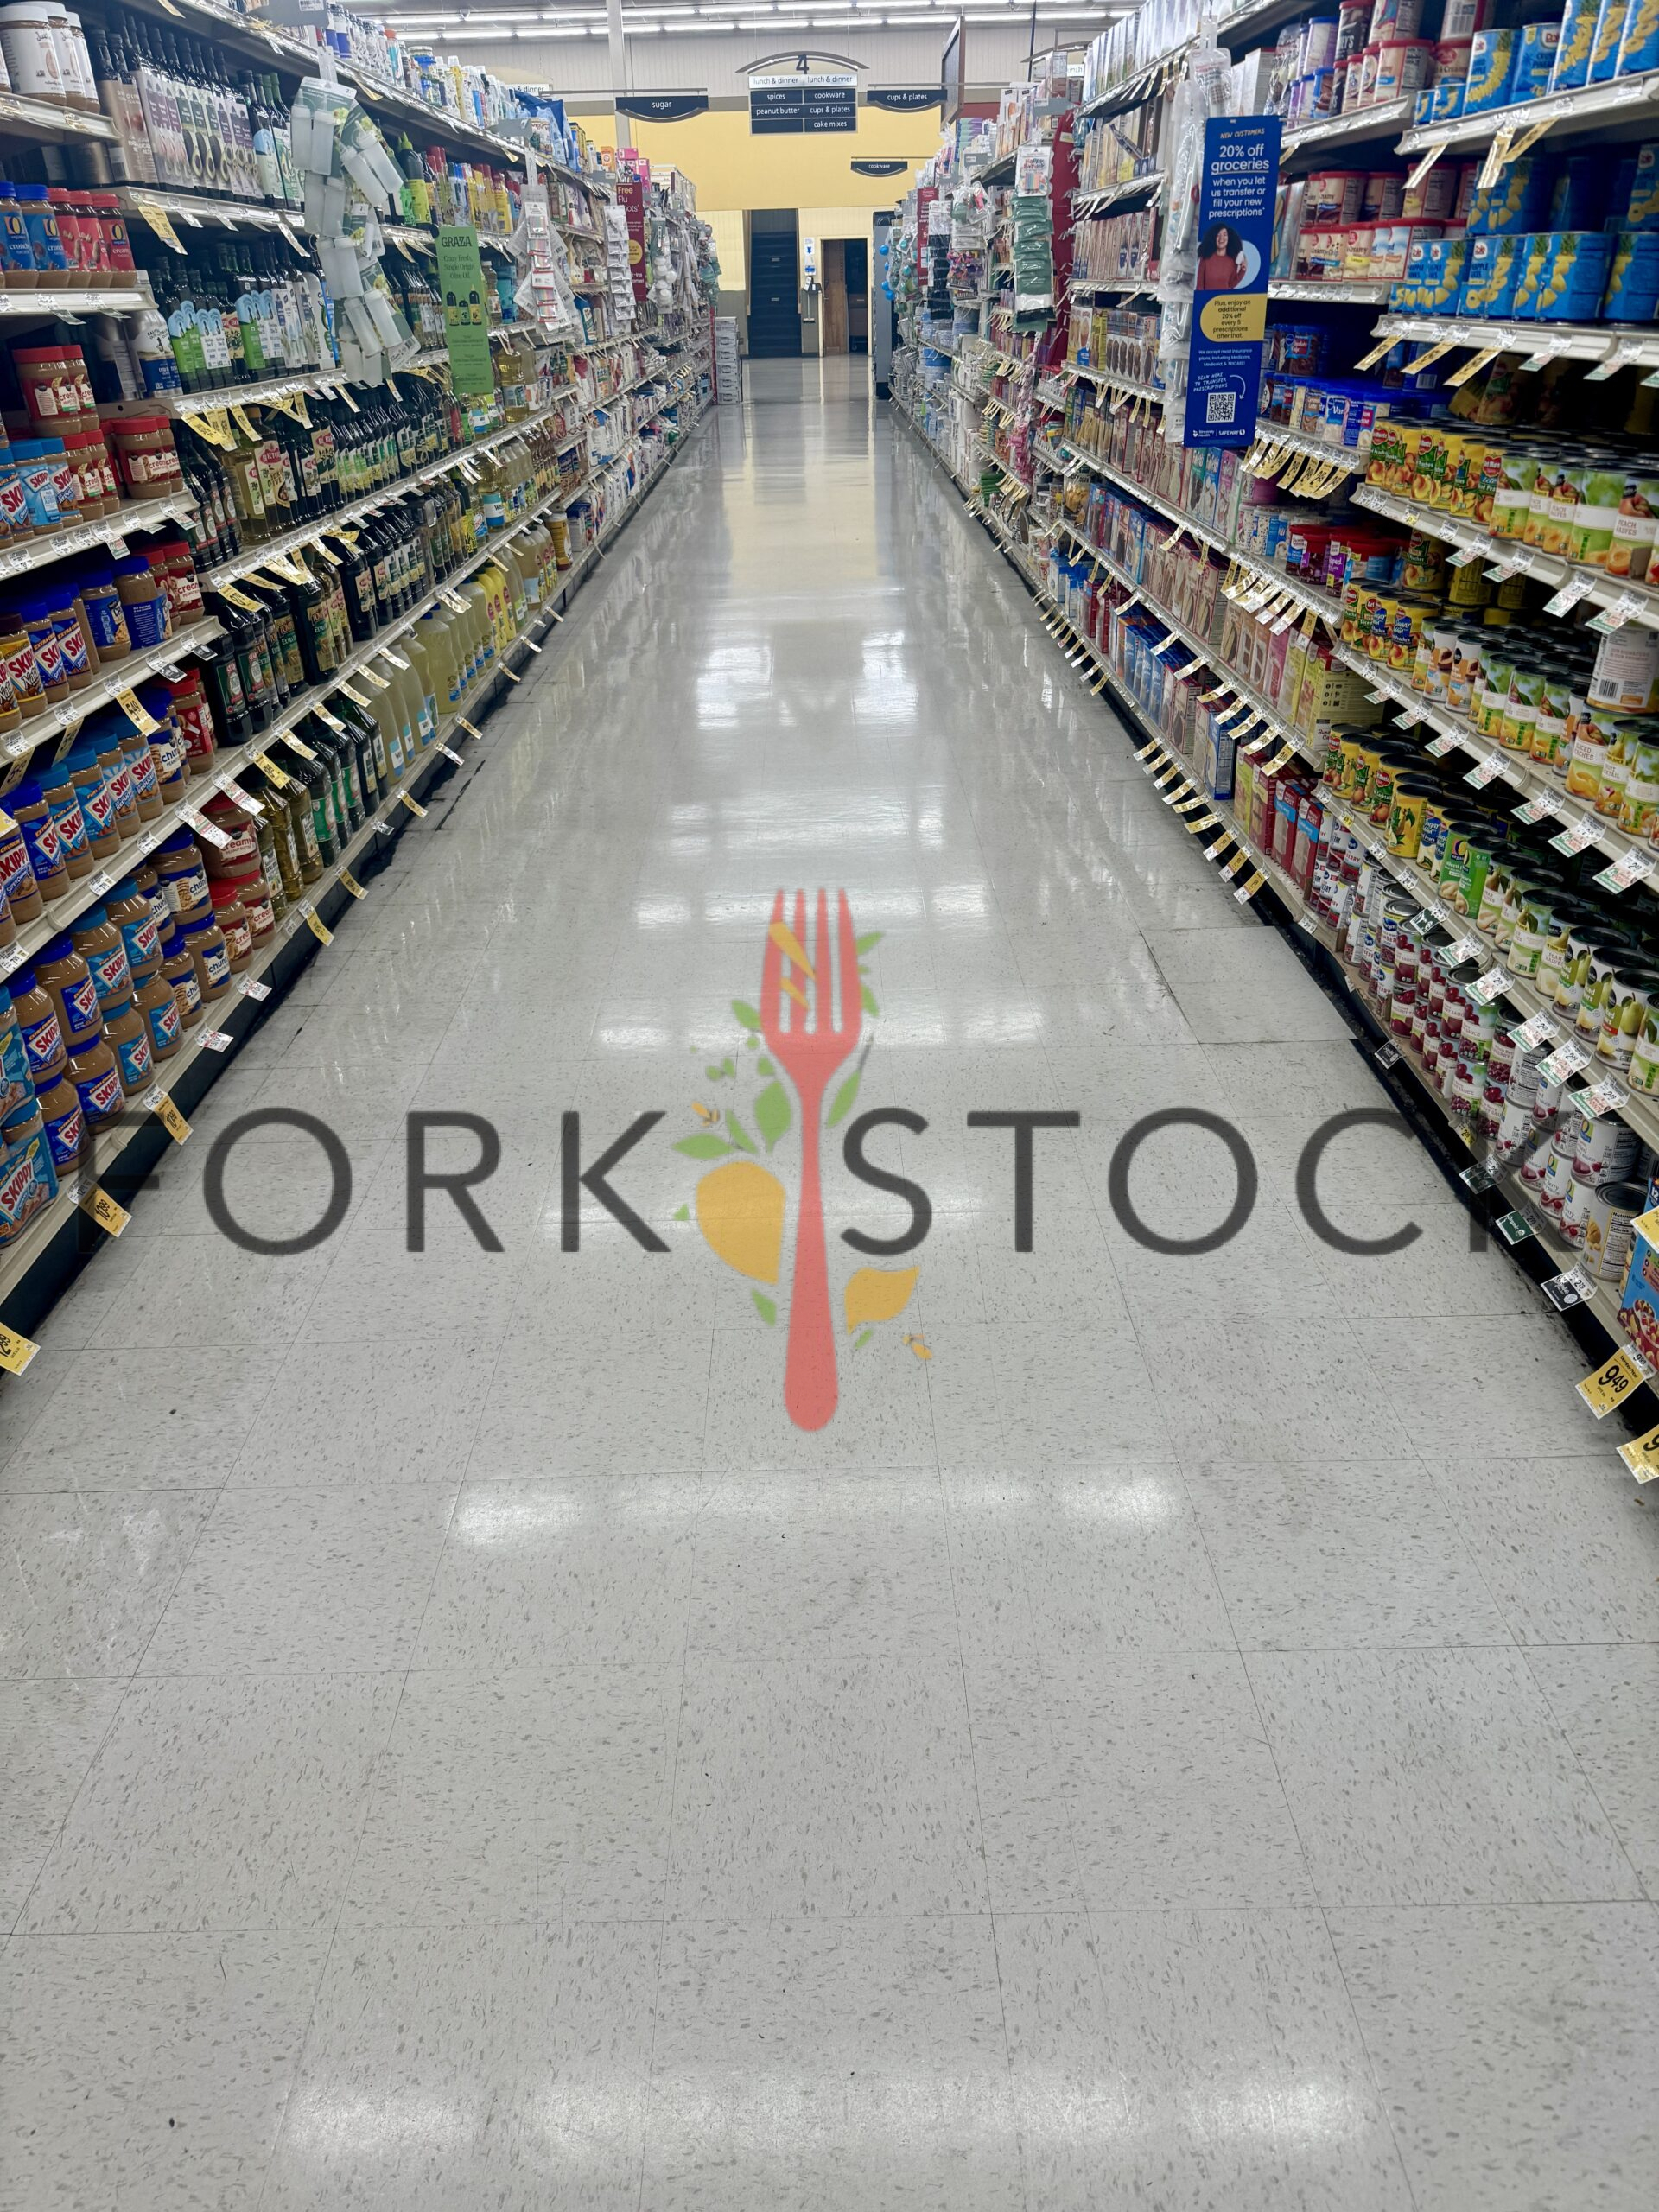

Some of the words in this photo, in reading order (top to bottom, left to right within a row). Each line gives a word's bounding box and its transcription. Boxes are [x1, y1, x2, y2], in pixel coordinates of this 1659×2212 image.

[796, 54, 809, 74] 4
[1066, 64, 1084, 73] unch
[652, 101, 672, 110] sugar
[831, 105, 850, 114] plates
[1219, 144, 1245, 157] 20%
[1247, 143, 1264, 157] off
[1211, 158, 1269, 174] groceries
[1213, 178, 1236, 187] when
[1237, 179, 1253, 188] you
[1255, 176, 1266, 185] let
[1223, 188, 1255, 196] transfer
[1213, 199, 1223, 207] fill
[1224, 200, 1243, 208] your
[442, 236, 472, 247] GRAZA
[2, 1161, 32, 1211] SKIPPY
